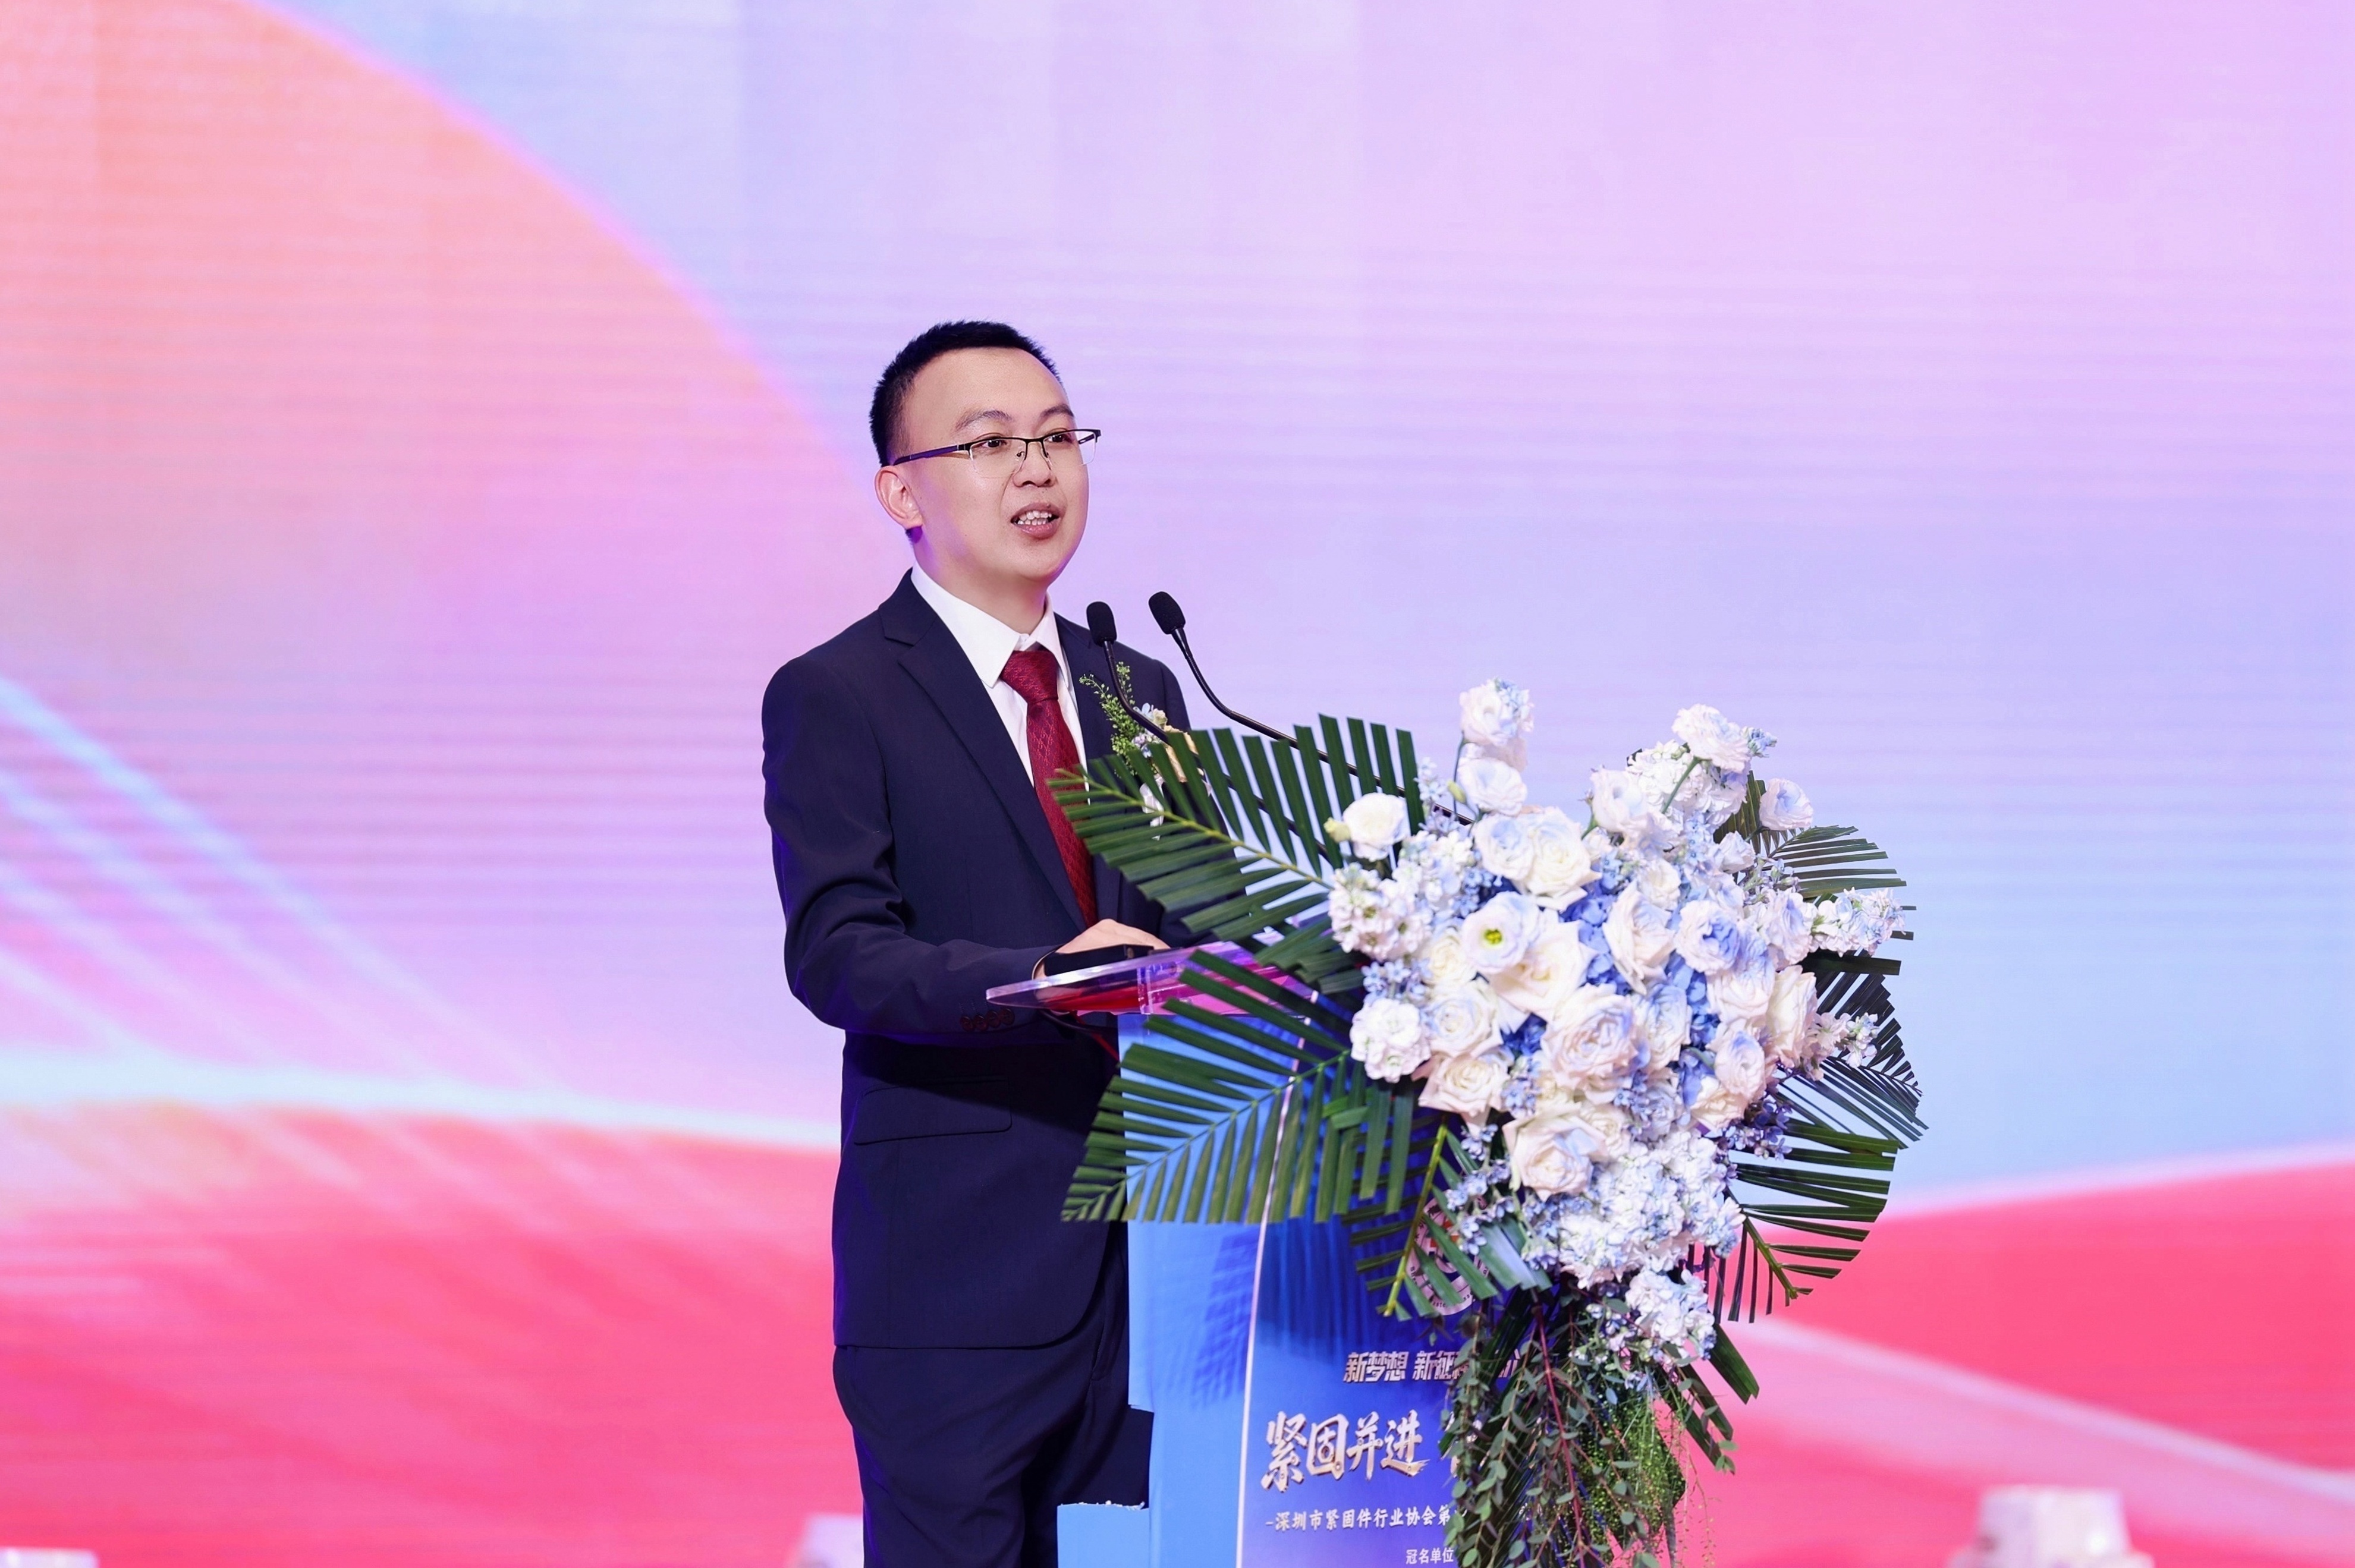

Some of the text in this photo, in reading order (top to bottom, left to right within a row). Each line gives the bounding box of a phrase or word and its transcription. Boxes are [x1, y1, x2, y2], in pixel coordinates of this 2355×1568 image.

[1344, 1351, 1408, 1383] 新梦想
[1260, 1409, 1430, 1493] 紧固并进
[1406, 1547, 1454, 1564] 冠名单位
